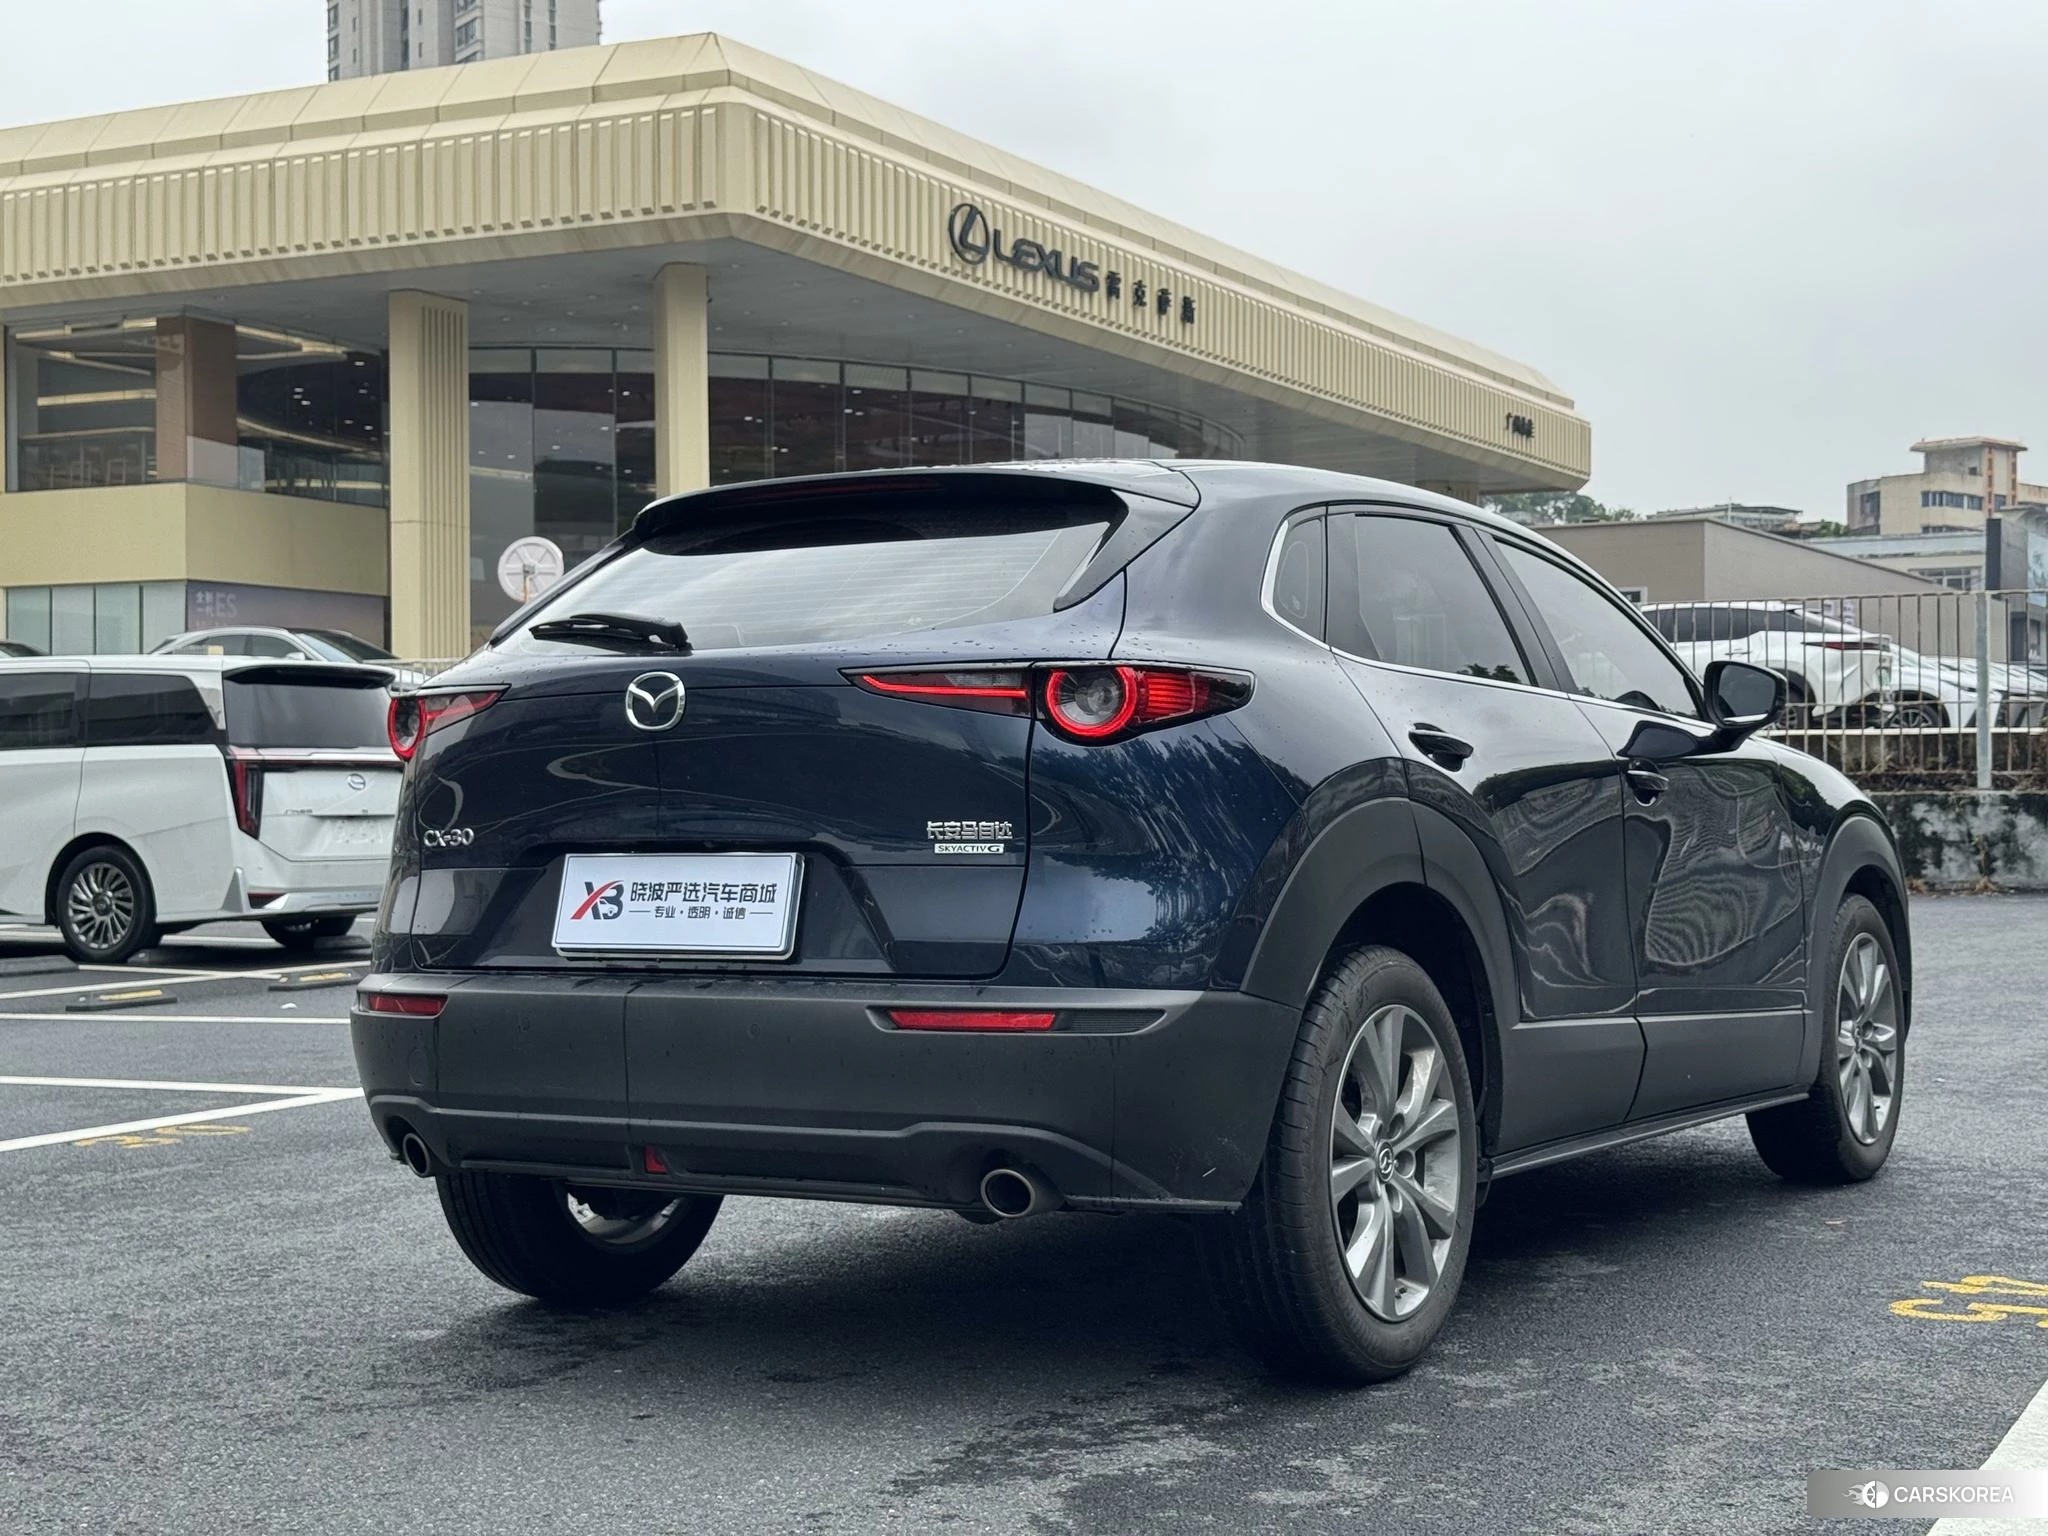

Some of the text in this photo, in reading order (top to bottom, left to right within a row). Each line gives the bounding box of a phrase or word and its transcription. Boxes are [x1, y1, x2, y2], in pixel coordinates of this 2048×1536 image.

[994, 229, 1099, 293] LEXUS
[424, 828, 474, 847] CX-30
[926, 821, 1012, 840] 长安马自达
[630, 881, 777, 903] 晓波严选汽车商城
